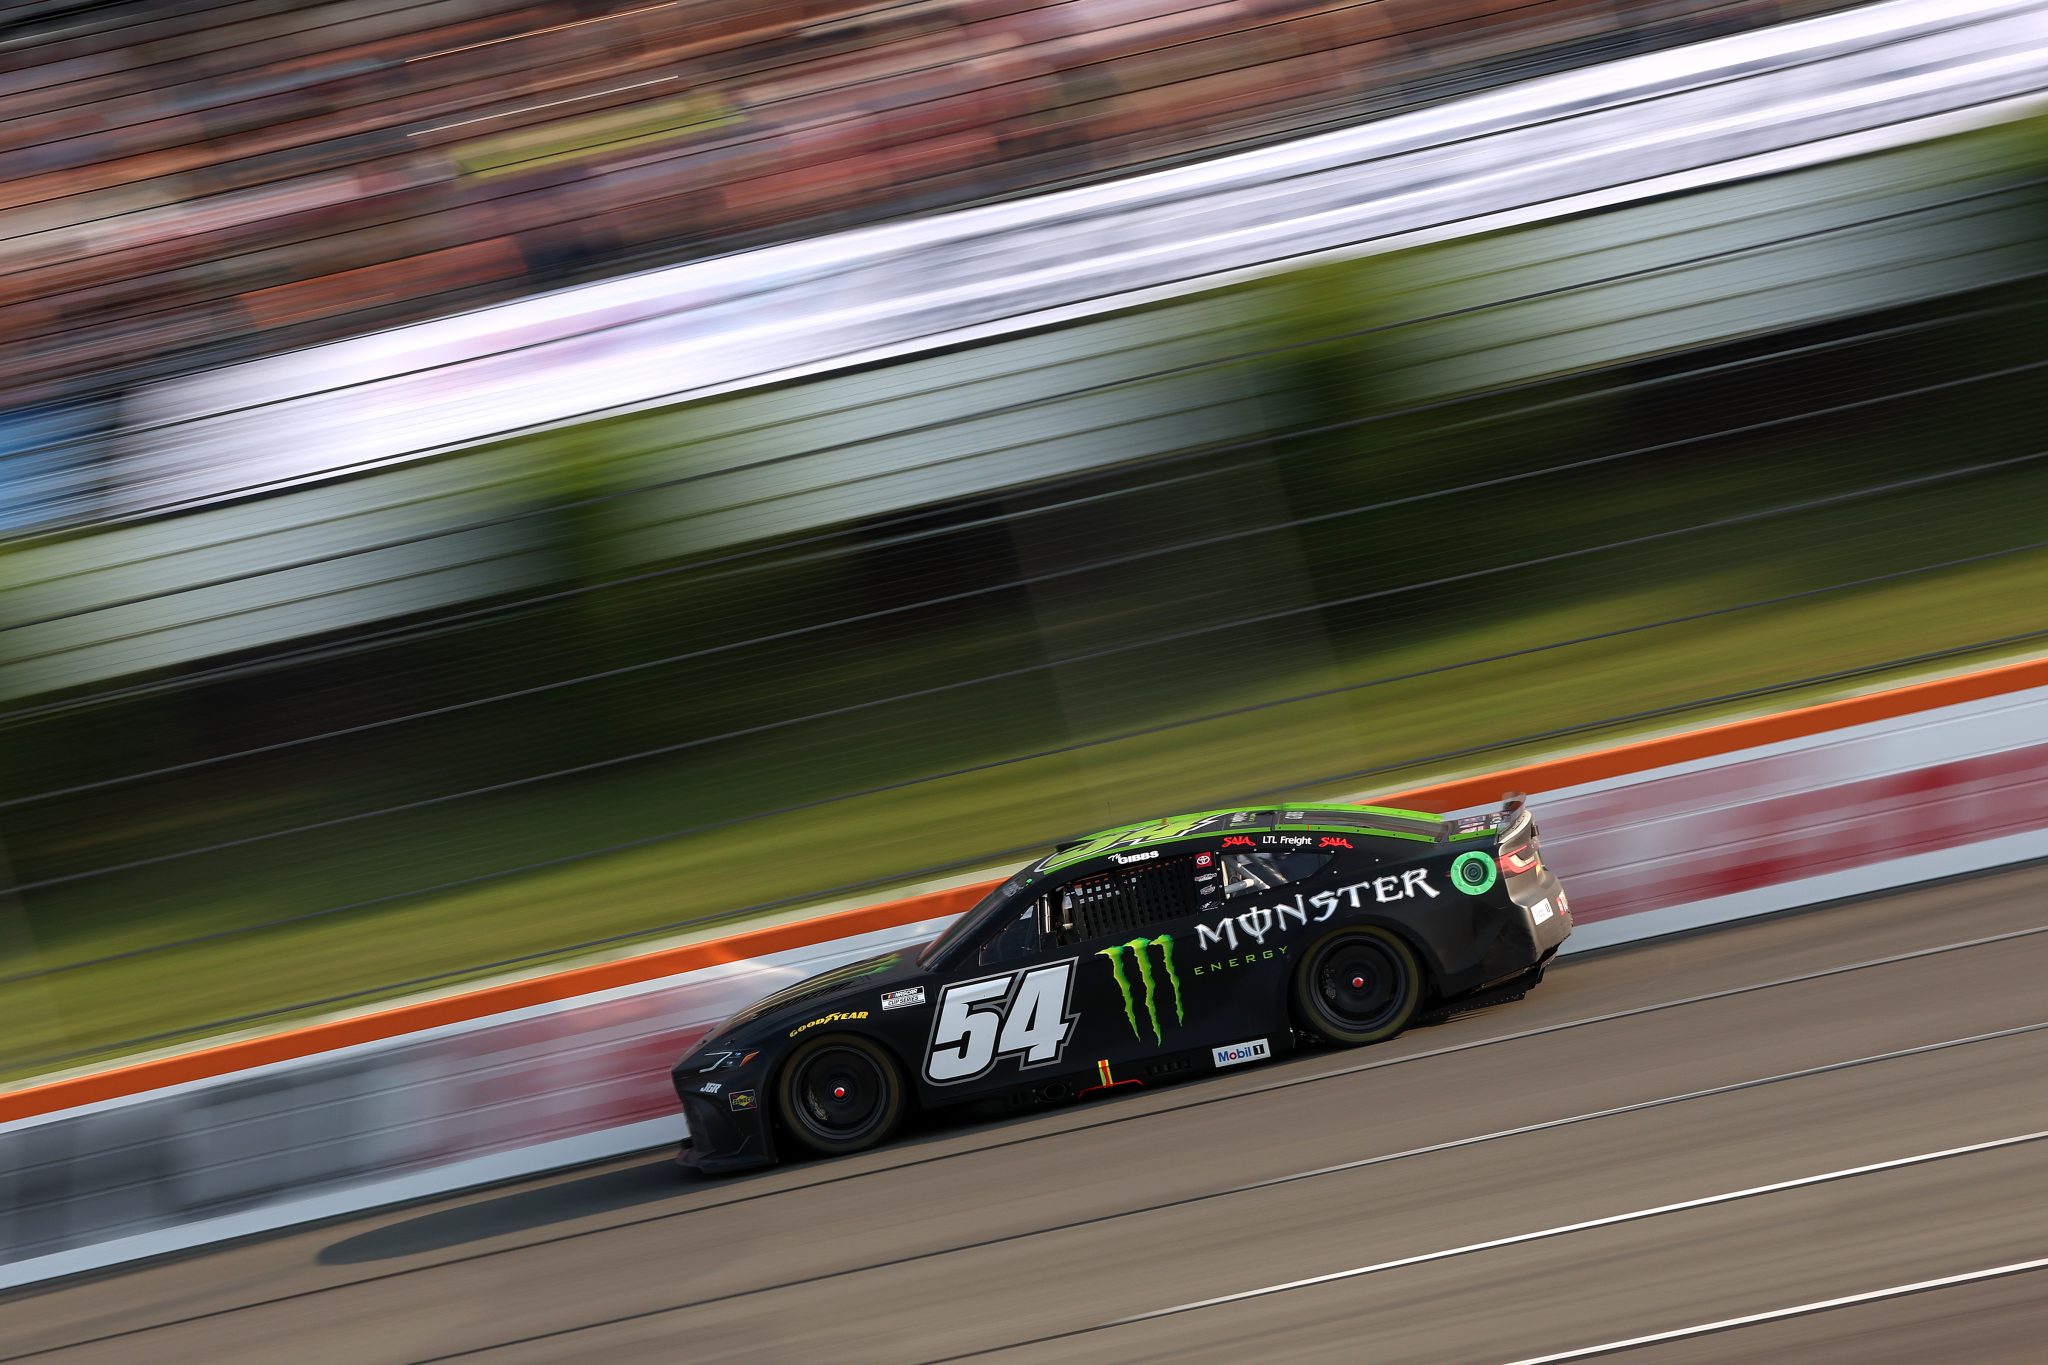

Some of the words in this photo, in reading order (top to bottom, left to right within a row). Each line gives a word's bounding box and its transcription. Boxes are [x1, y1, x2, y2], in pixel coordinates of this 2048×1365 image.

[1221, 836, 1256, 848] SAIA
[1262, 836, 1277, 844] LTL
[1280, 836, 1312, 846] Freight
[1318, 837, 1353, 849] SAIA
[1118, 850, 1159, 865] GIBBS
[1194, 868, 1440, 951] MONSTER
[1194, 945, 1288, 976] ENERGY
[789, 1011, 869, 1038] GOODYEAR
[922, 957, 1080, 1087] 54
[1218, 1047, 1252, 1062] Mobil
[699, 1082, 722, 1094] JGR
